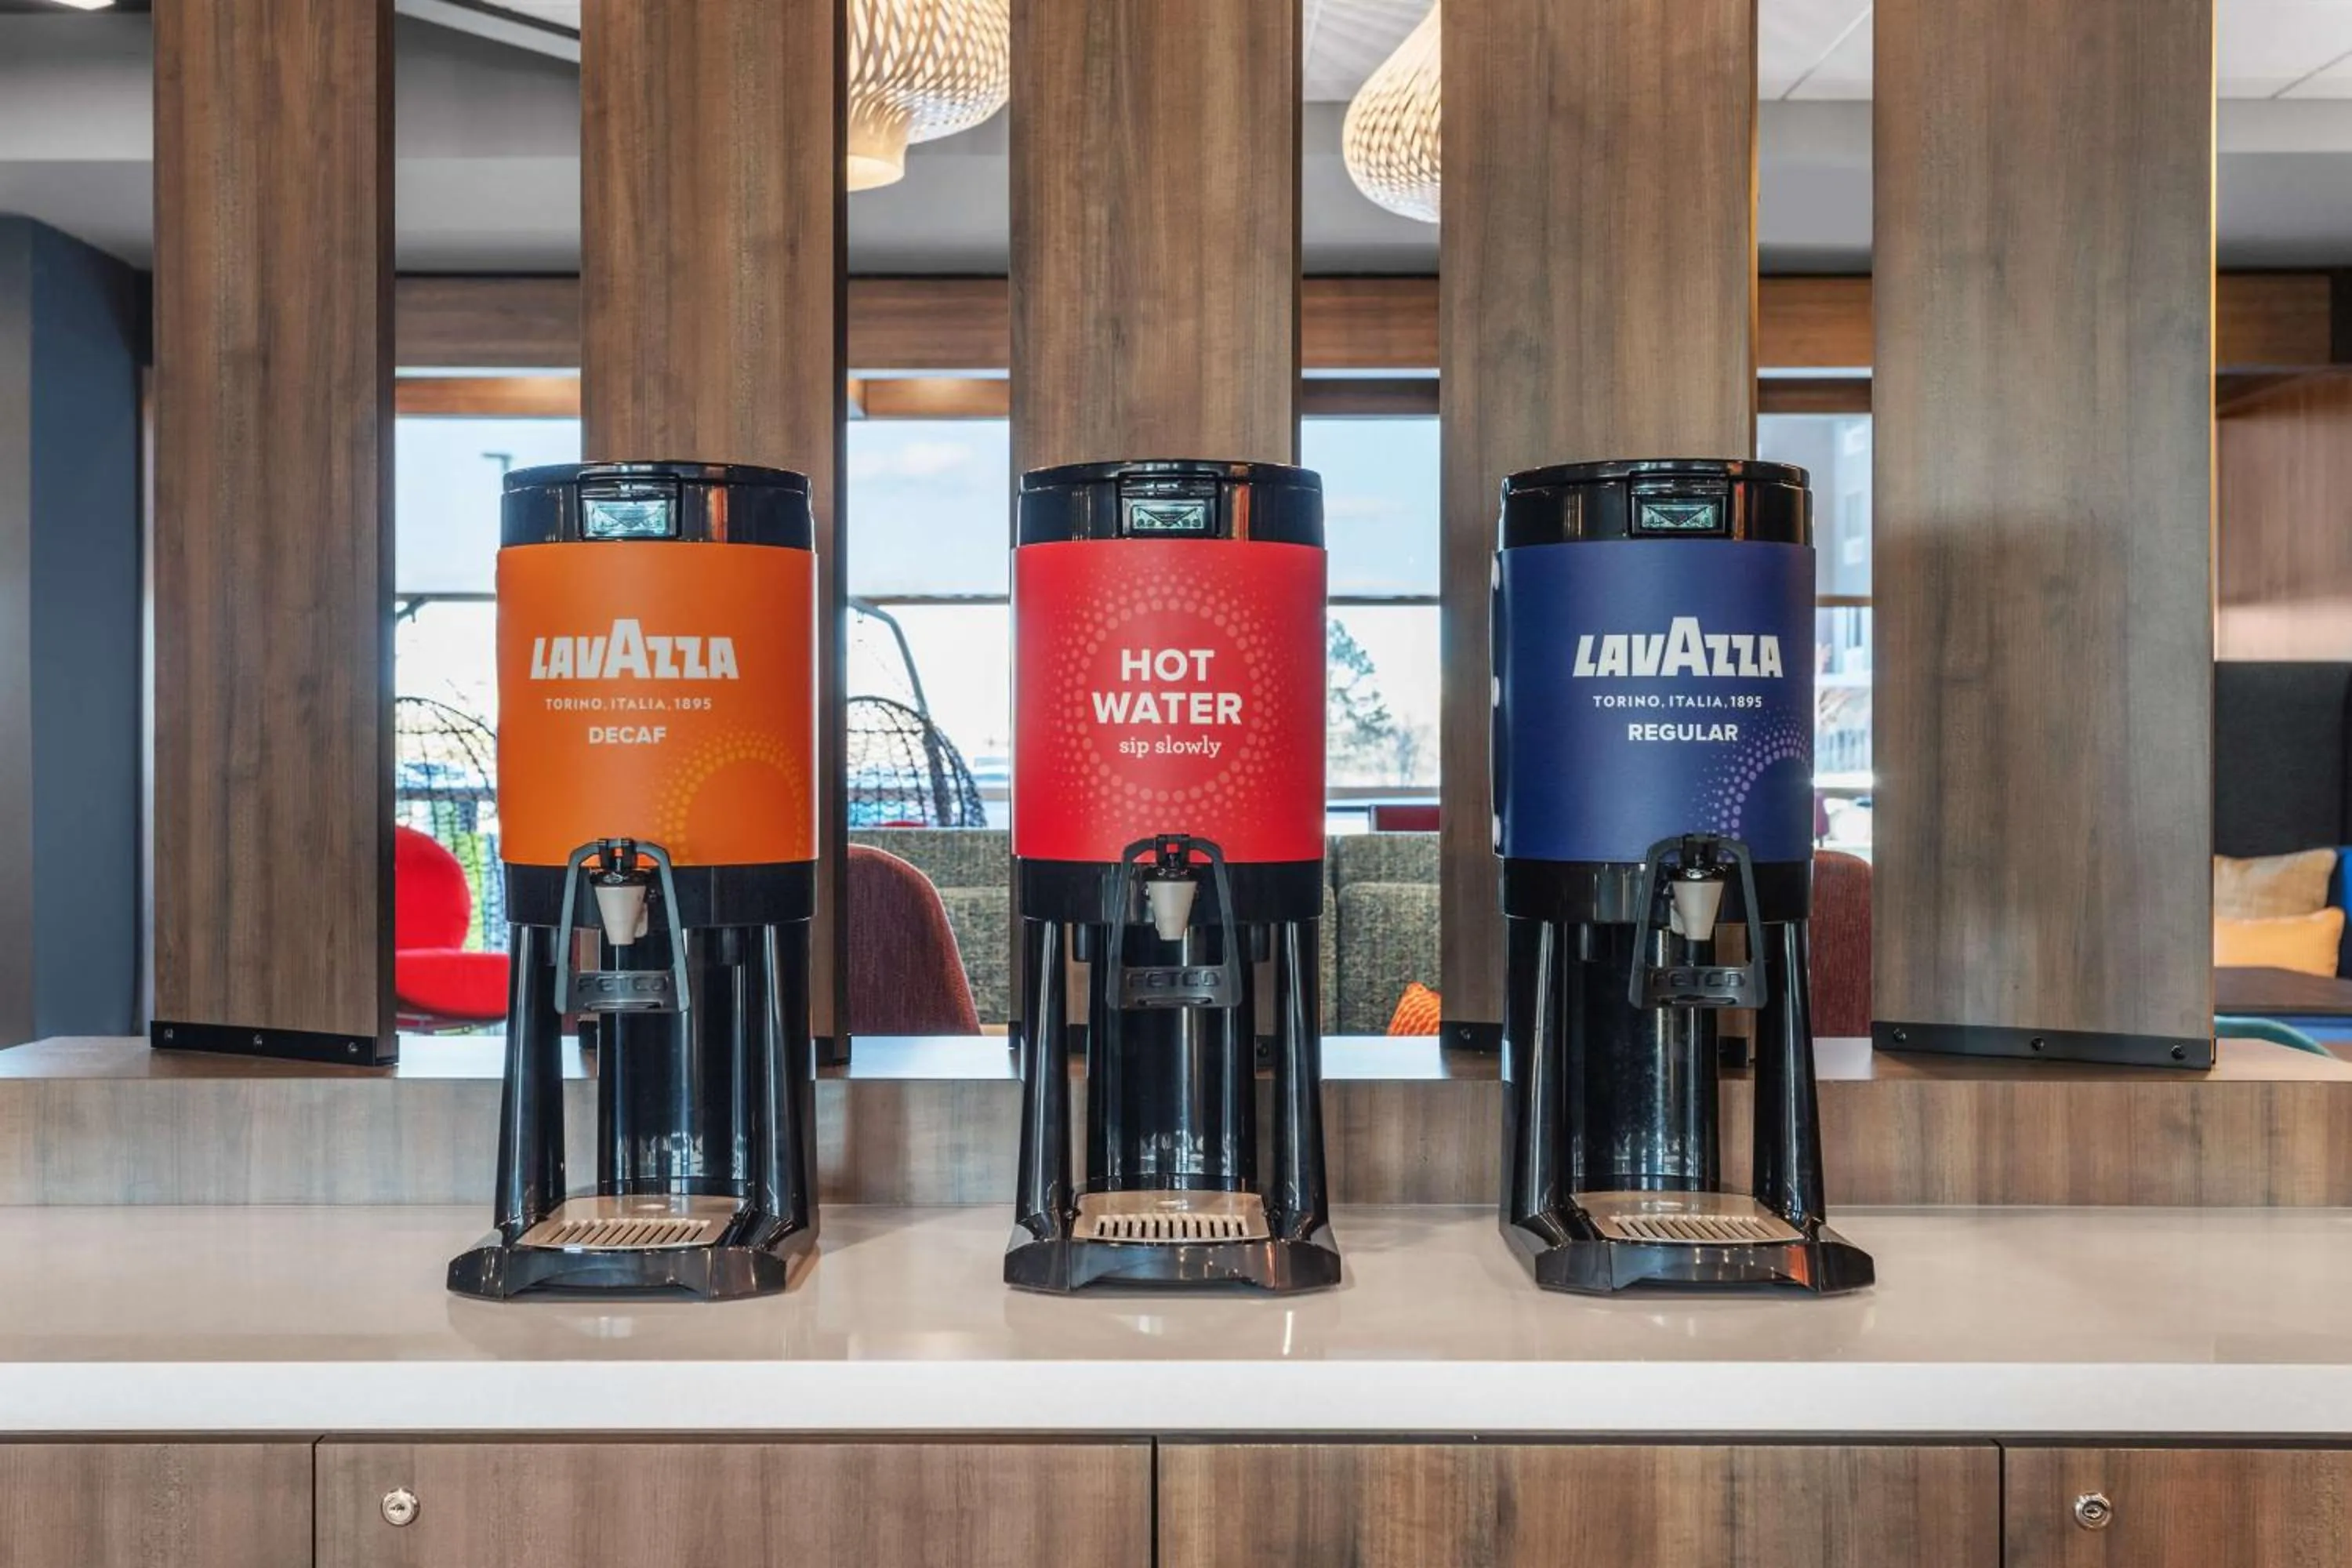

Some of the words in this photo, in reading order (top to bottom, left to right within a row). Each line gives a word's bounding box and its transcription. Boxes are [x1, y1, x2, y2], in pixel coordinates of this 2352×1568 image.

[529, 618, 740, 681] LAVAZZA
[1572, 615, 1784, 678] LAVAZZA
[1121, 648, 1215, 682] HOT
[674, 697, 713, 710] 1895
[1091, 691, 1243, 725] WATER
[1730, 695, 1762, 709] 1895
[588, 726, 668, 745] DECAF
[1628, 724, 1738, 742] REGULAR
[1119, 737, 1150, 759] sip
[1155, 735, 1222, 759] slowly
